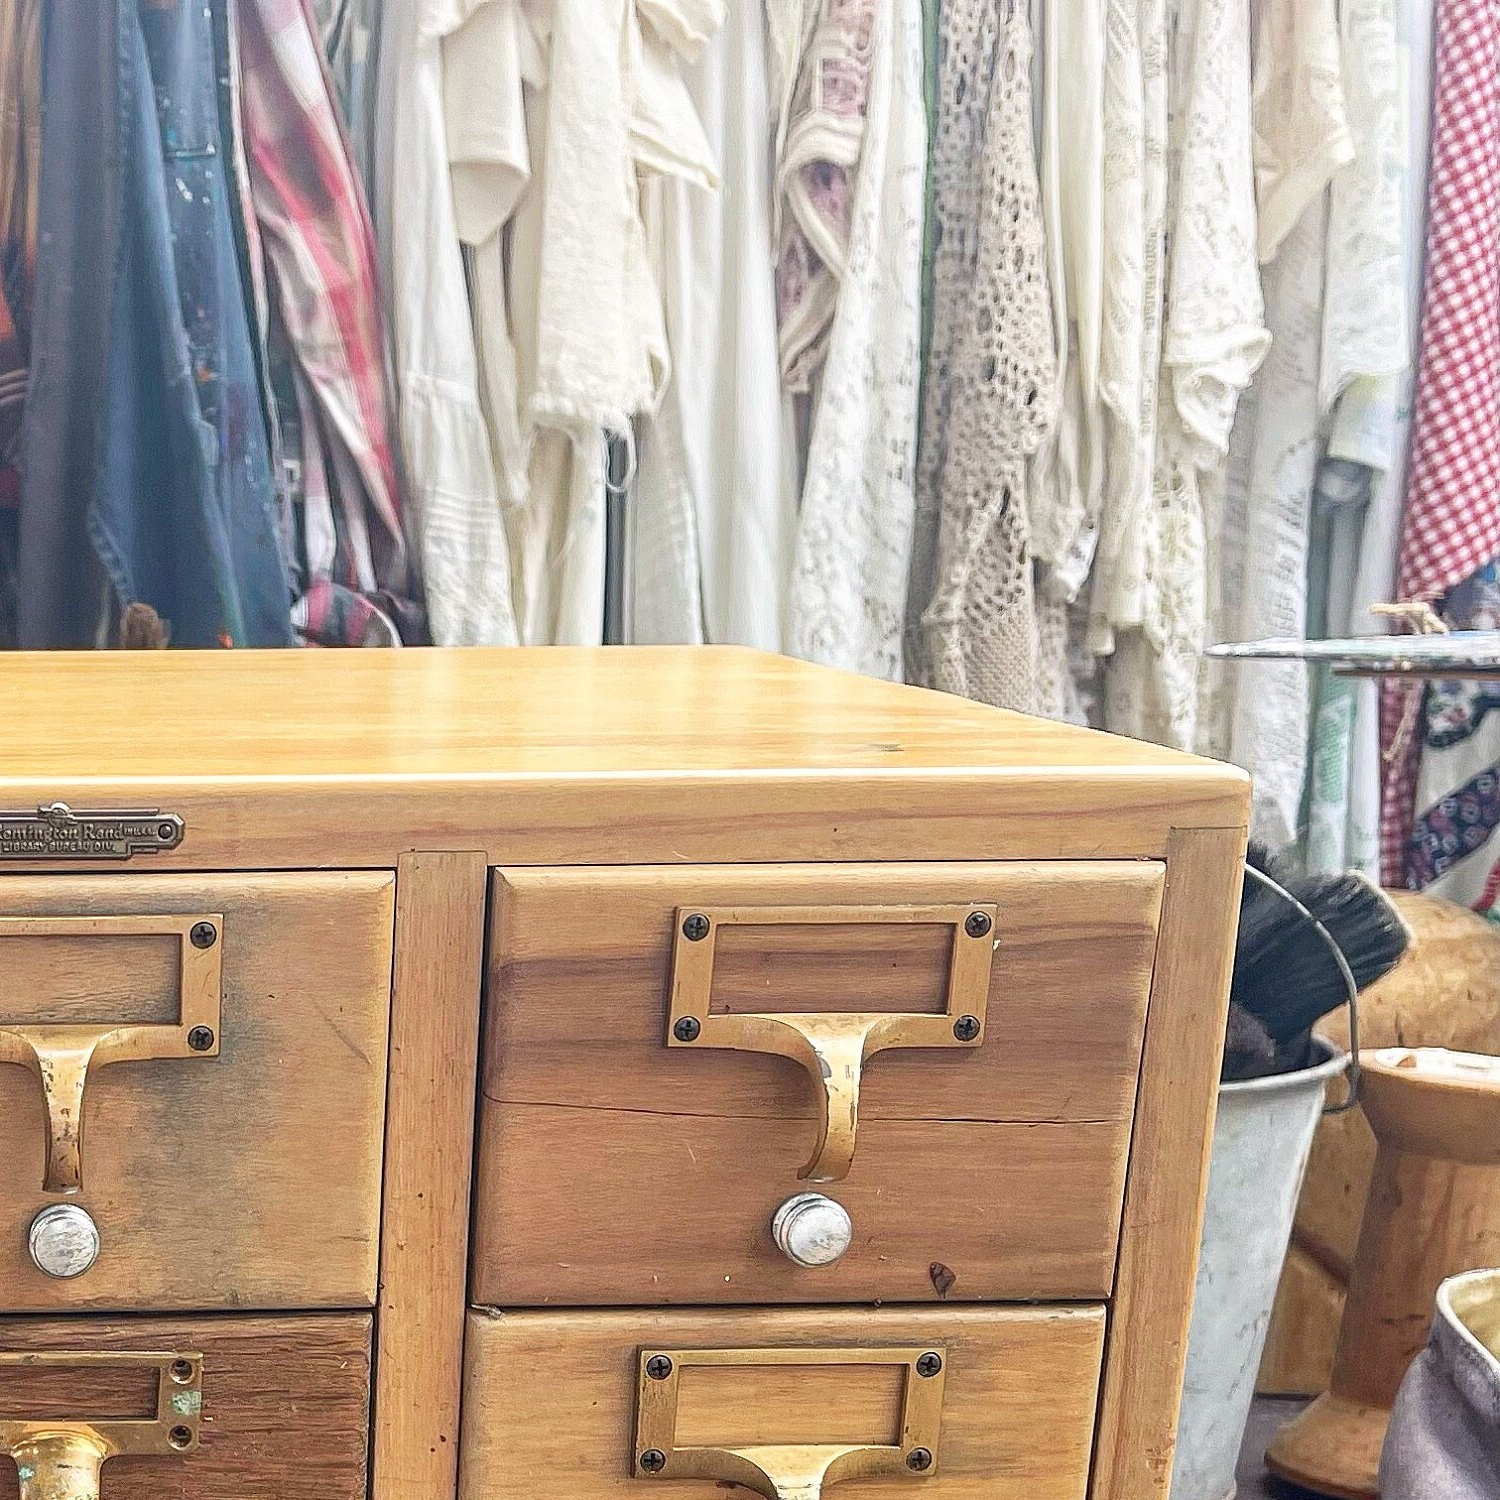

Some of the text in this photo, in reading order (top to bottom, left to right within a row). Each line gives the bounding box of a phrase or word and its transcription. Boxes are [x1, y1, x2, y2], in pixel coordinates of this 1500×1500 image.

[83, 822, 124, 840] Rand
[2, 840, 45, 852] LIBRARY
[48, 840, 89, 852] BUREAU
